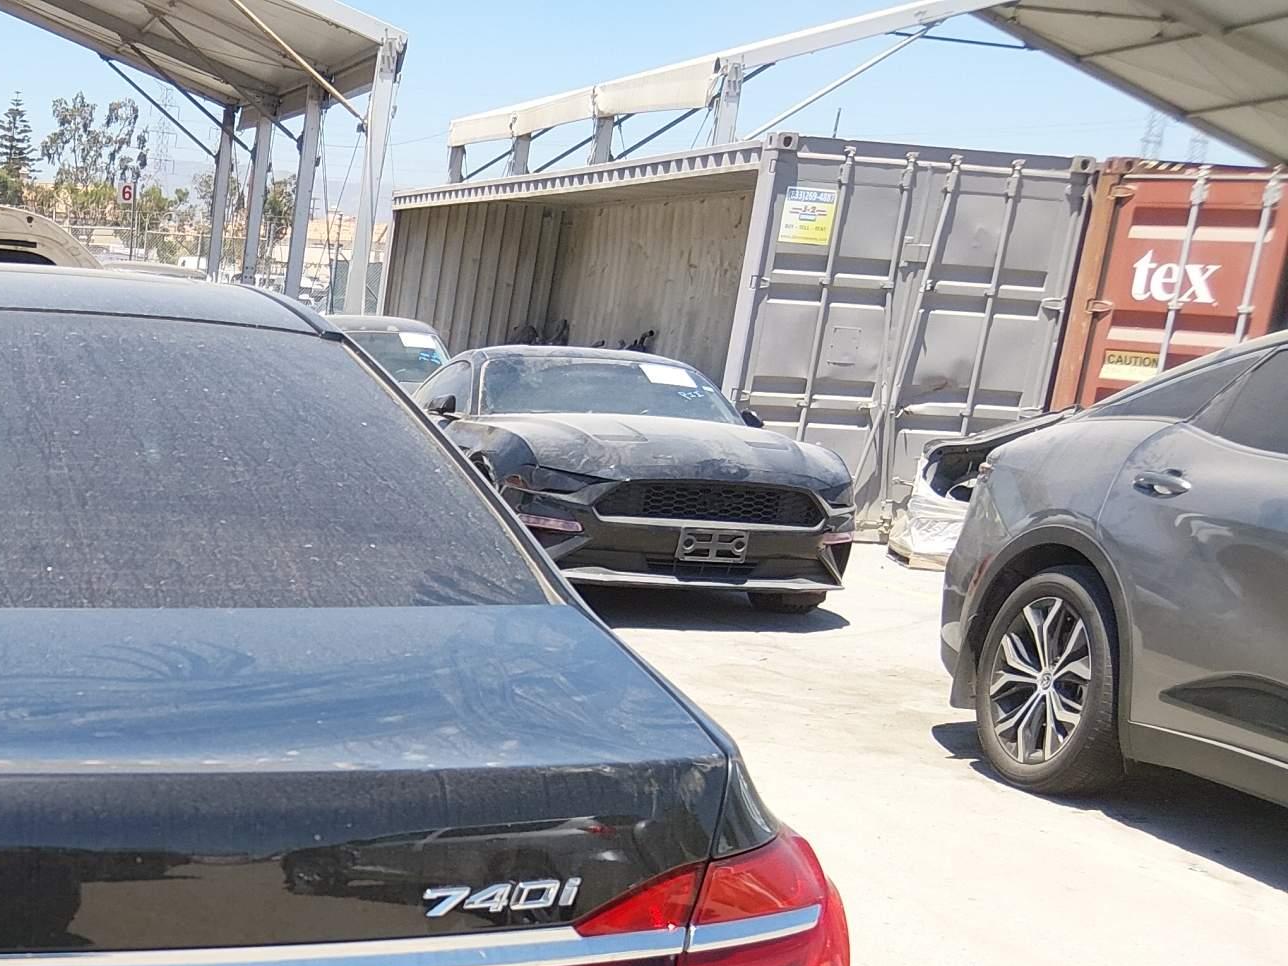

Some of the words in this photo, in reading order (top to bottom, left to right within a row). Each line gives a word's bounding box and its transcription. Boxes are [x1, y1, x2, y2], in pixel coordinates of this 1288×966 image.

[122, 185, 132, 201] 6
[1131, 249, 1222, 304] tex
[1107, 353, 1159, 369] CAUTION
[422, 877, 582, 917] 740i
